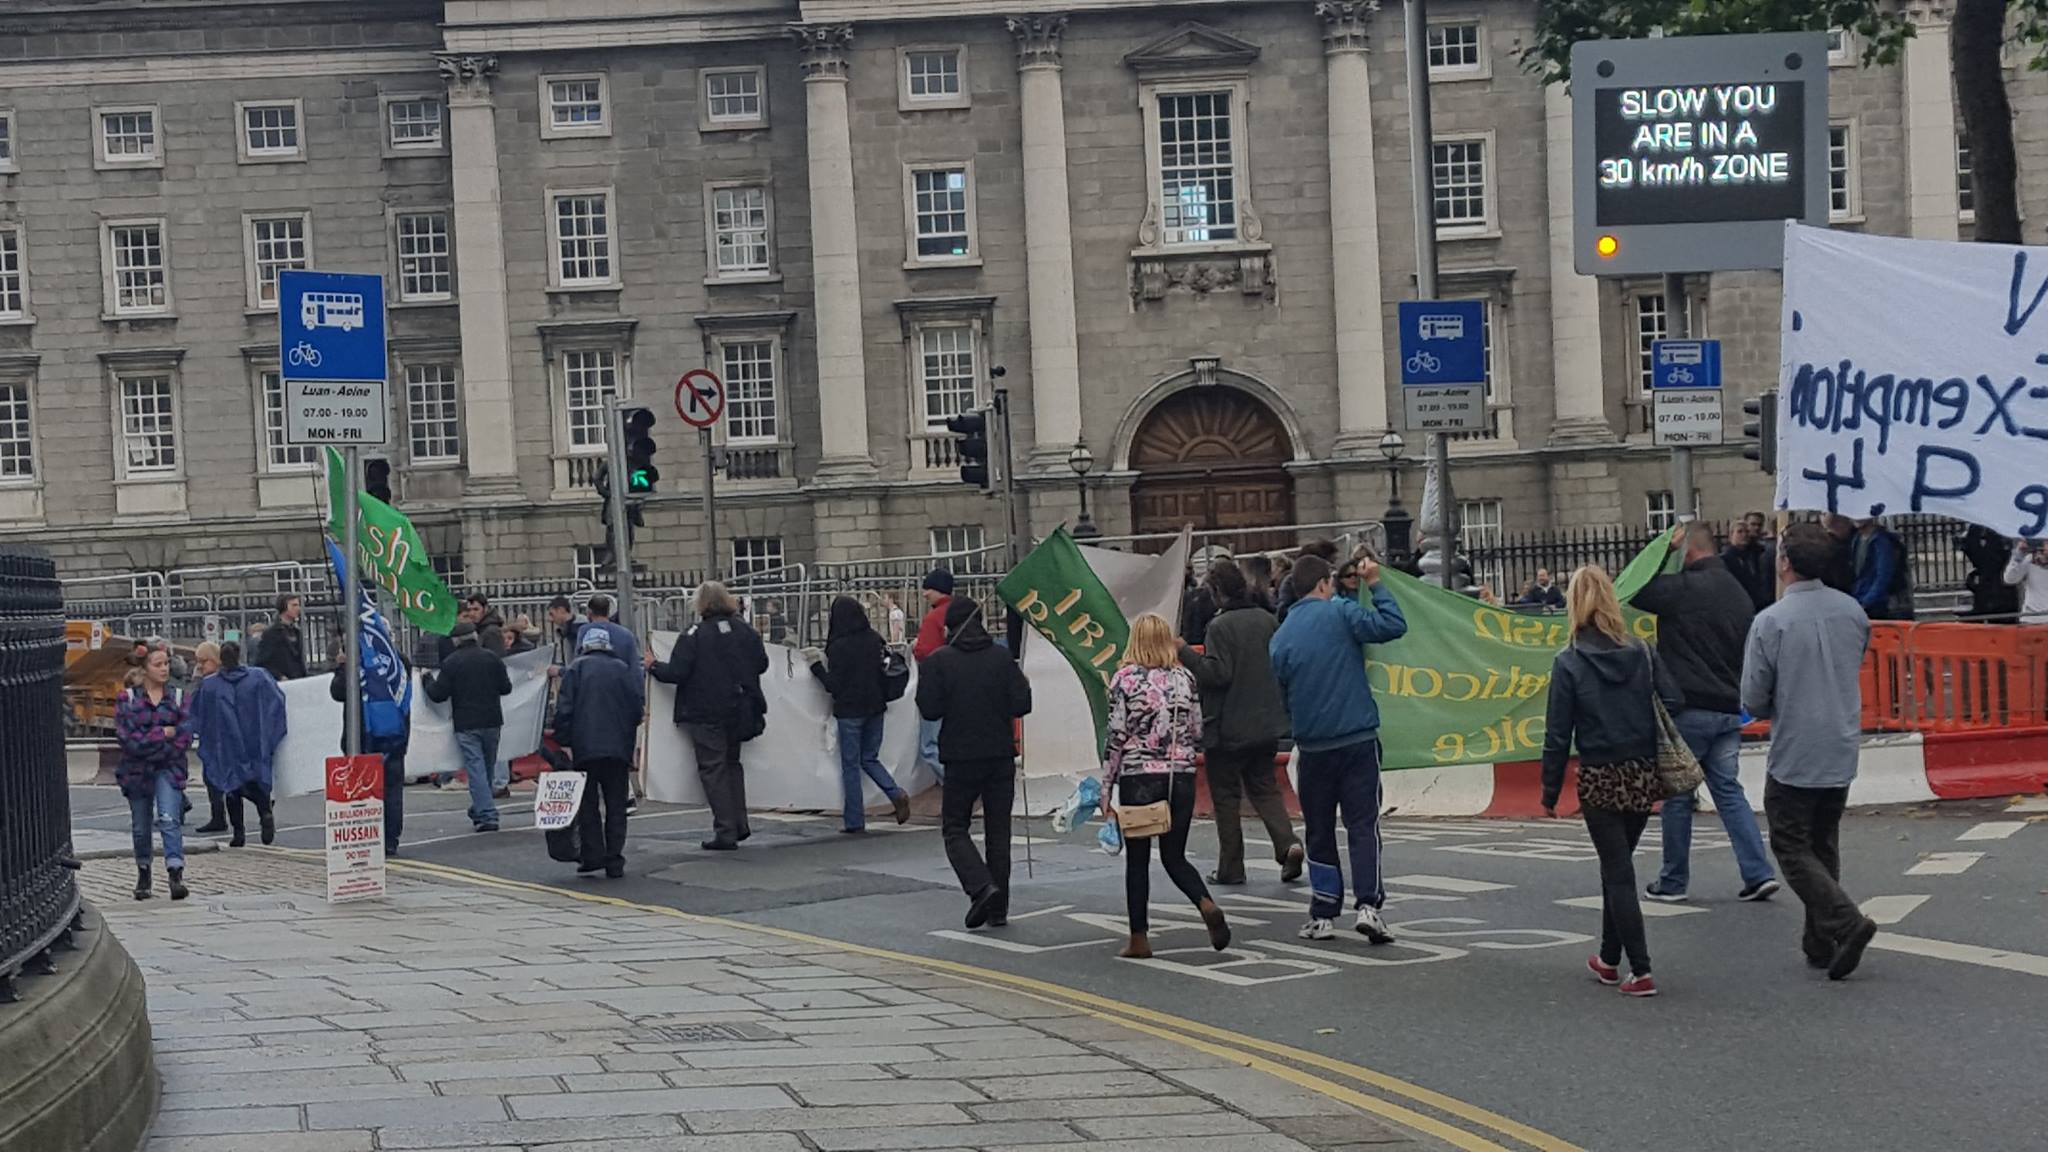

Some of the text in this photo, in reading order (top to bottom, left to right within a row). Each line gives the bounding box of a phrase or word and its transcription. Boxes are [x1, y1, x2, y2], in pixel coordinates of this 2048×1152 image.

[1621, 85, 1776, 114] SLOW YOU
[1632, 120, 1757, 148] ARE IN A
[1600, 152, 1789, 183] 30 km/h ZONE
[303, 407, 331, 418] 07.00
[341, 407, 368, 418] 19.00
[334, 826, 380, 843] HUSSAIN
[1113, 917, 1597, 987] BUS
